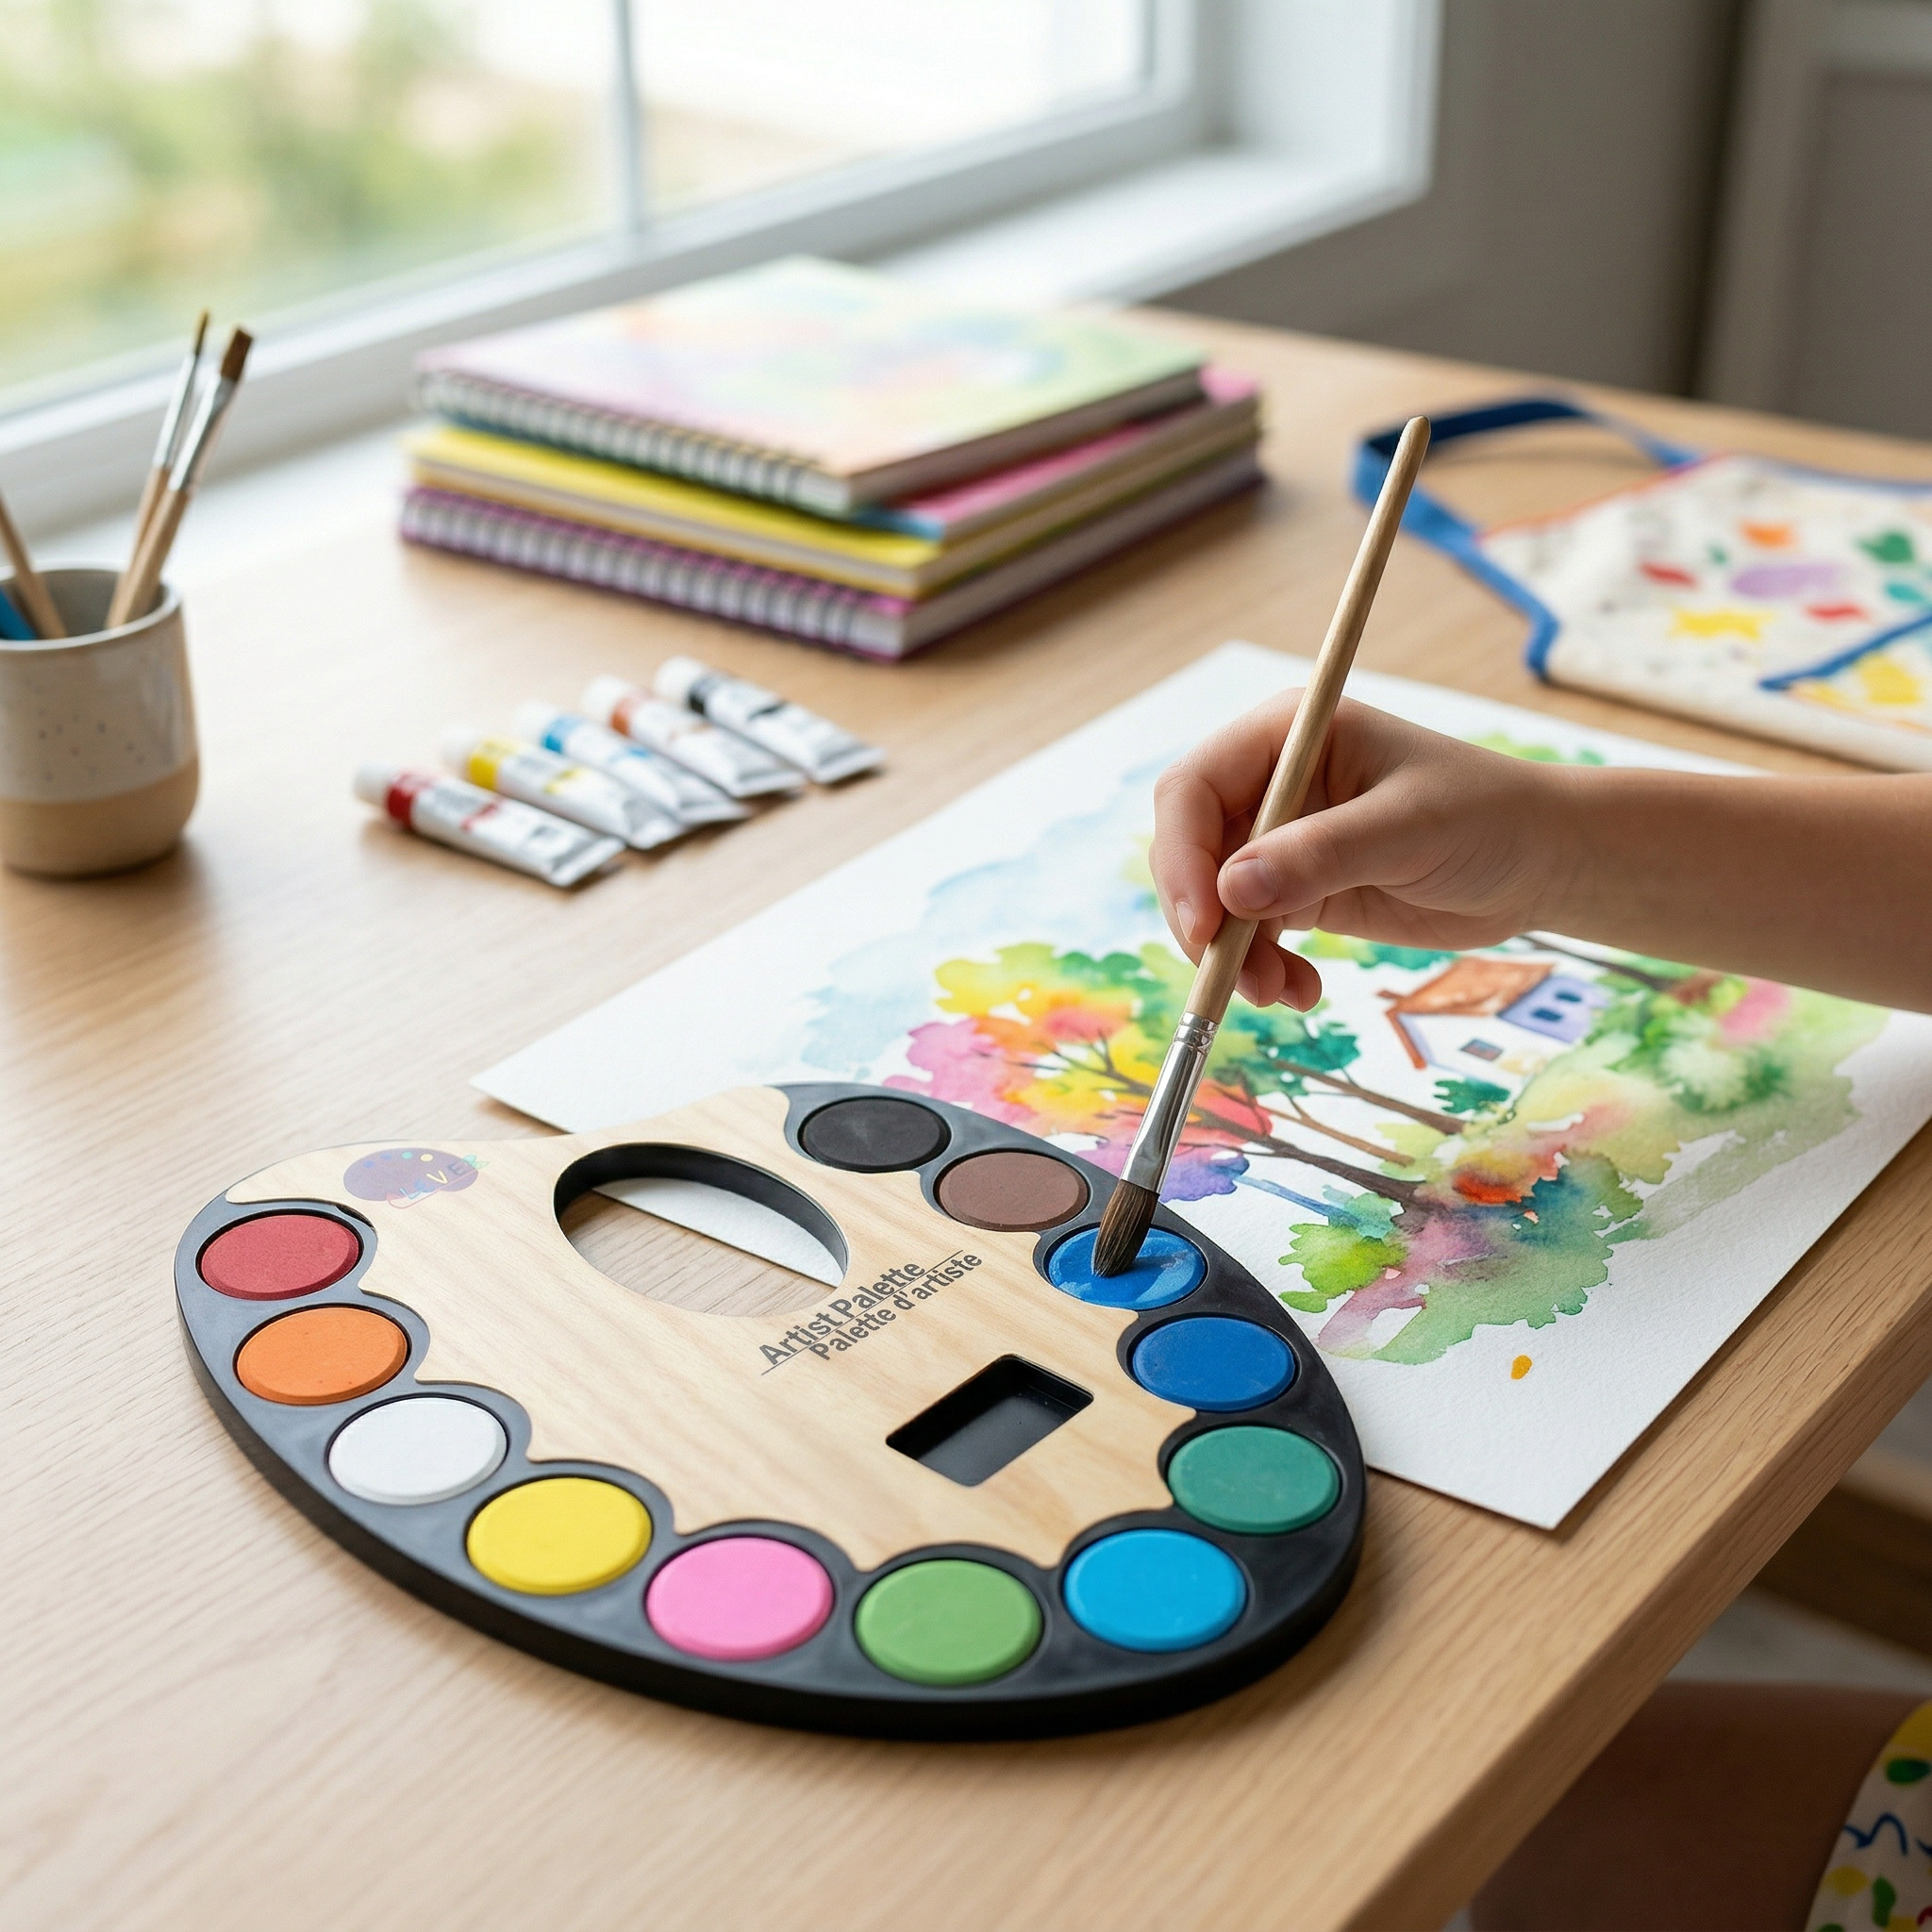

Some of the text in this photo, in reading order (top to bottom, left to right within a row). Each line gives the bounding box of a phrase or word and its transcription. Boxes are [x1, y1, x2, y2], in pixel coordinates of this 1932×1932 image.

[758, 1262, 925, 1366] Artist Palette
[808, 1253, 983, 1361] Palette d'artiste
